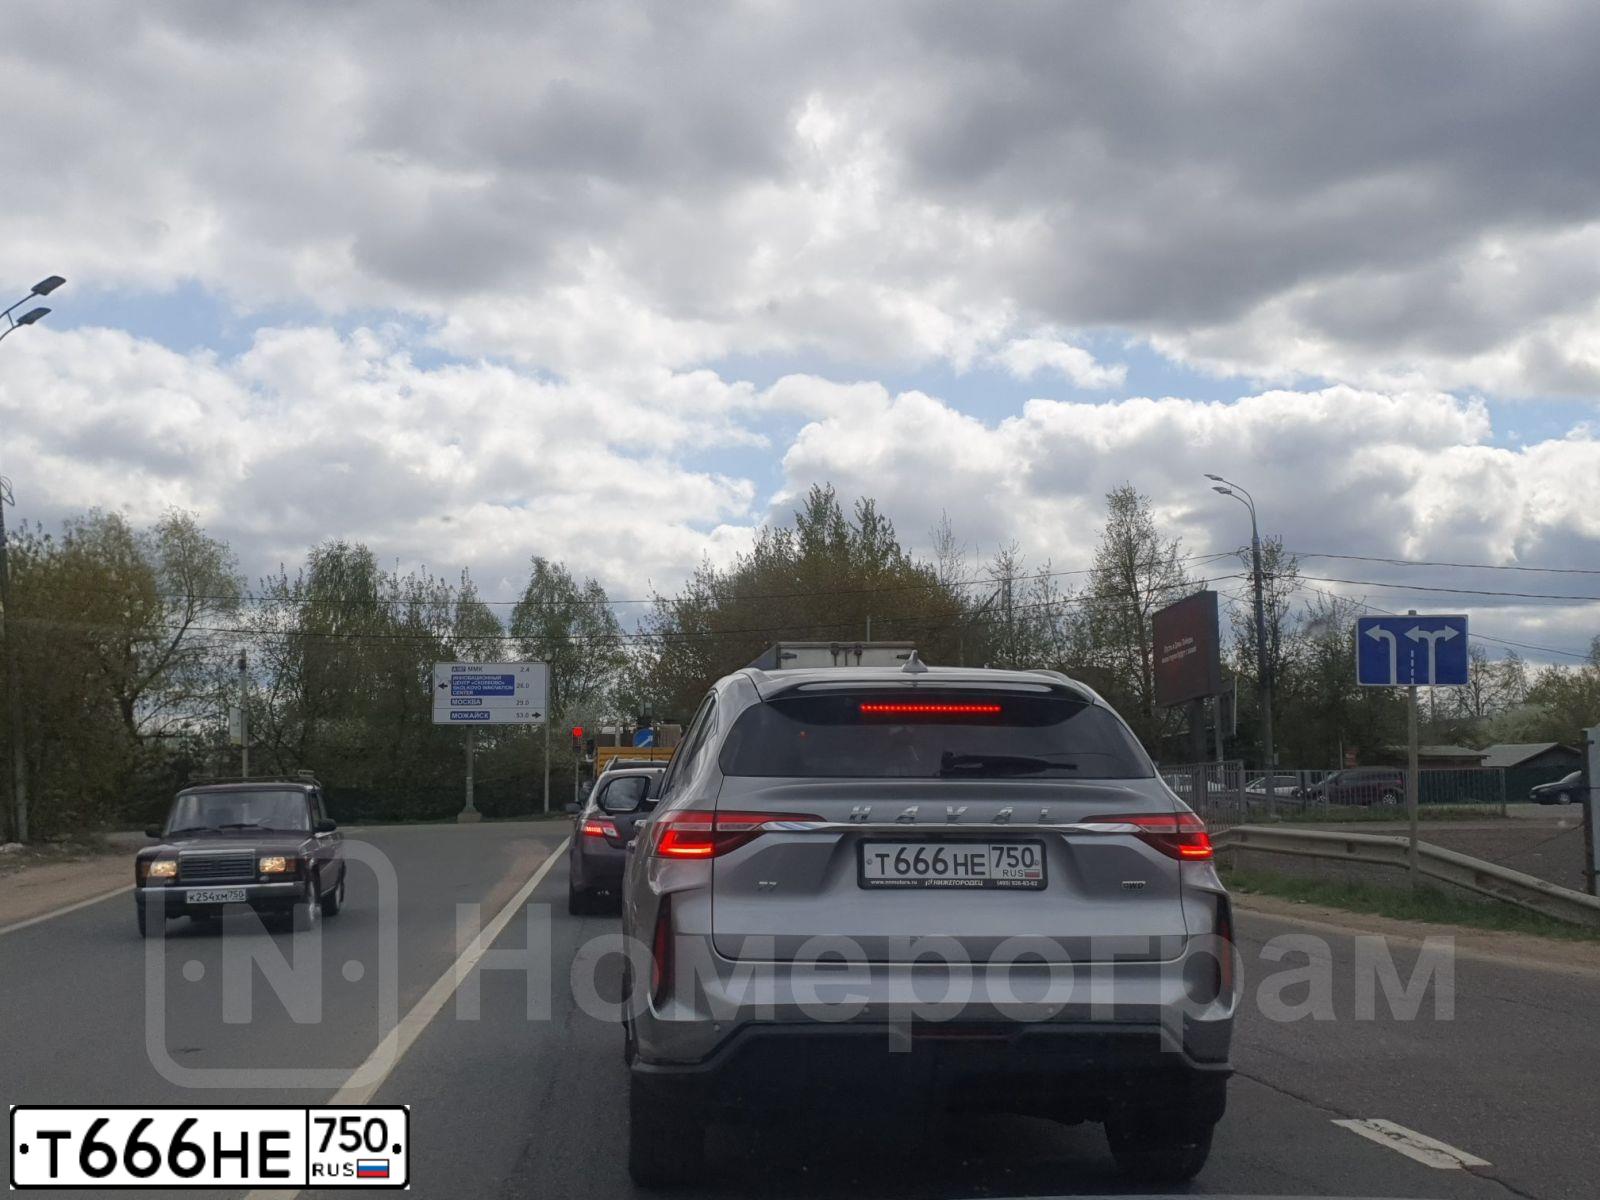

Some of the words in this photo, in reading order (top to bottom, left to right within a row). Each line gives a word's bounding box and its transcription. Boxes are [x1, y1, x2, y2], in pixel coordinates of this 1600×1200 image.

[451, 711, 489, 719] МОЖАЙСК
[991, 846, 1035, 869] 750
[1002, 869, 1024, 878] RUS
